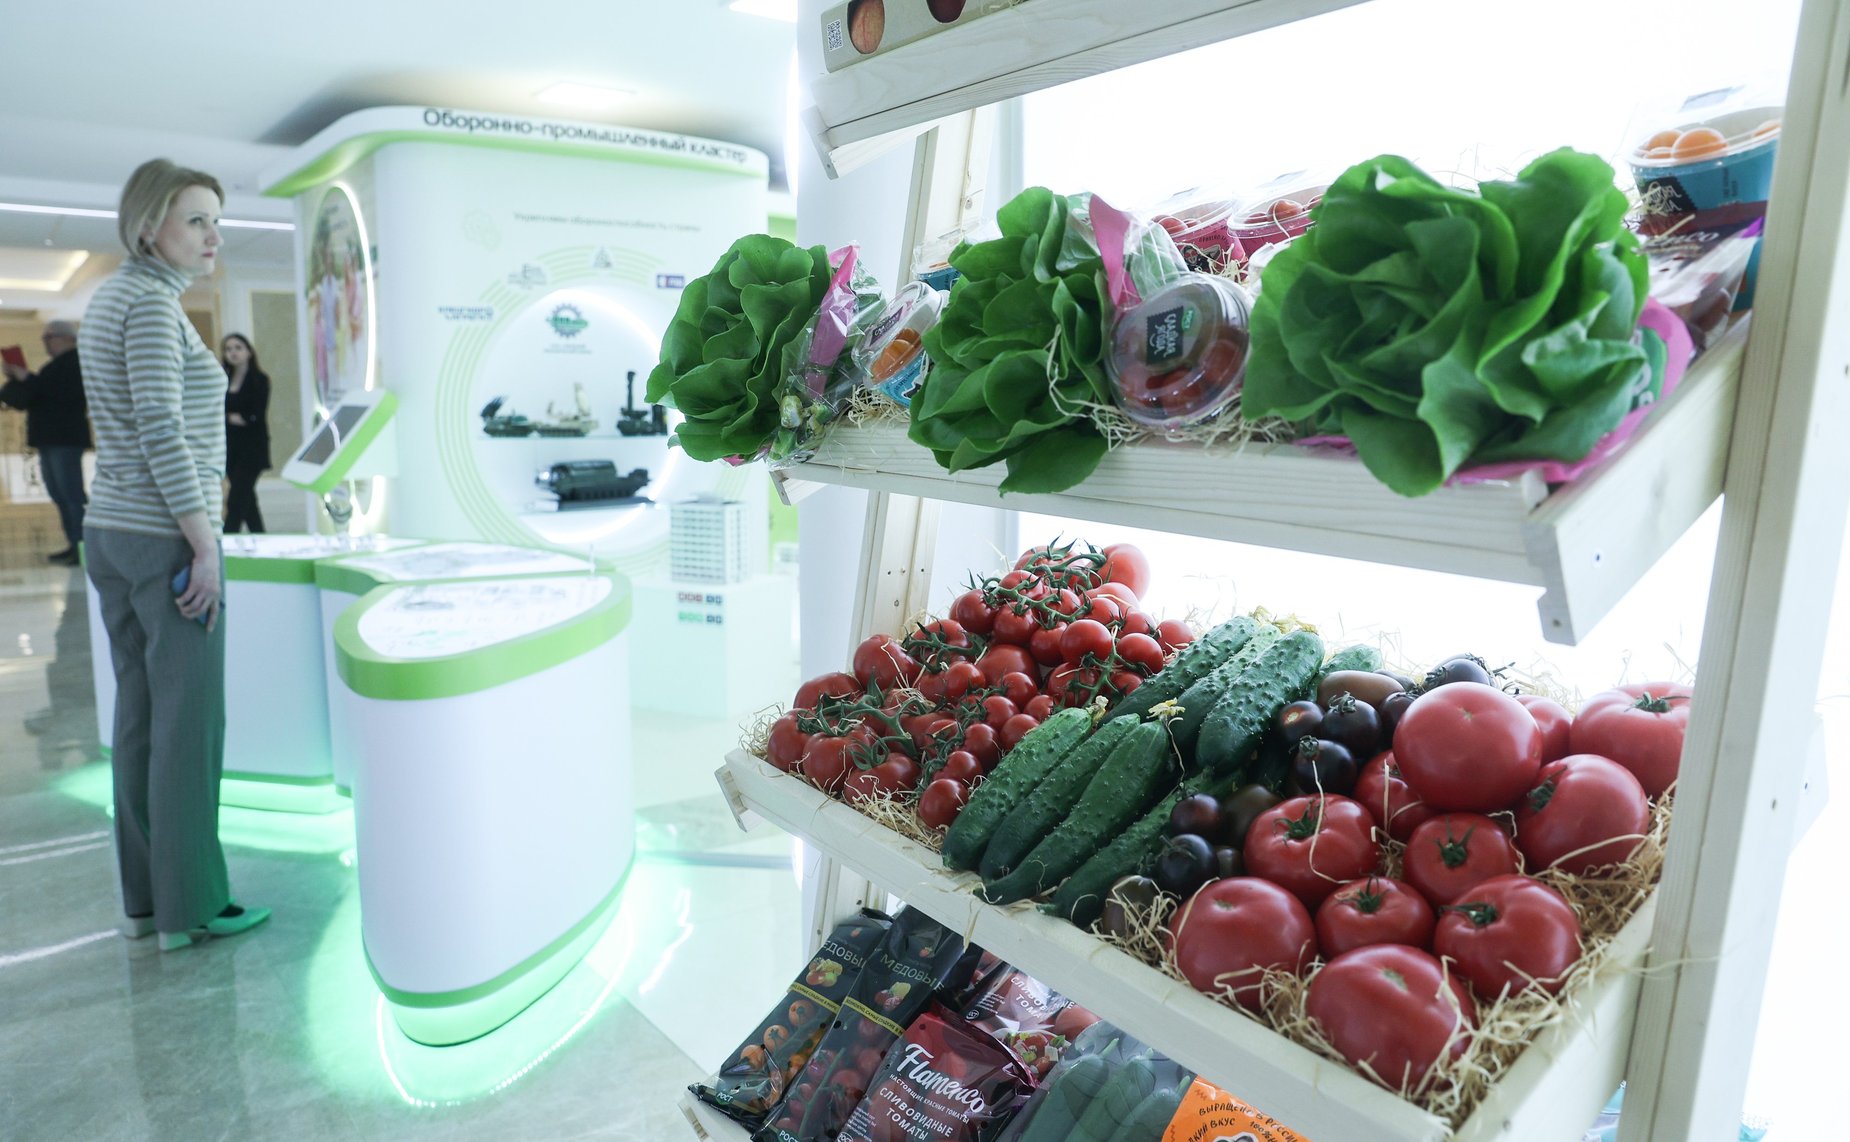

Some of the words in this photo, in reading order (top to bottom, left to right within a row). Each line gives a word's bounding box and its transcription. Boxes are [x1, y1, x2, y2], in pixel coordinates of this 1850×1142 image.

[424, 108, 686, 151] Оборонно-промышленный
[822, 940, 868, 969] ЕДОВЫ
[880, 953, 944, 993] МЕДОВЫЕ
[897, 1043, 985, 1113] Flamenco
[879, 1087, 954, 1138] СЛИВОВИДНЫЕ
[889, 1073, 924, 1102] НАСТОЯЩИЕ
[923, 1097, 946, 1112] КРАСНЫЕ
[945, 1107, 970, 1125] ТОМАТЫ
[886, 1107, 929, 1141] ТОМАТЫ
[1210, 1117, 1235, 1129] ВКУС
